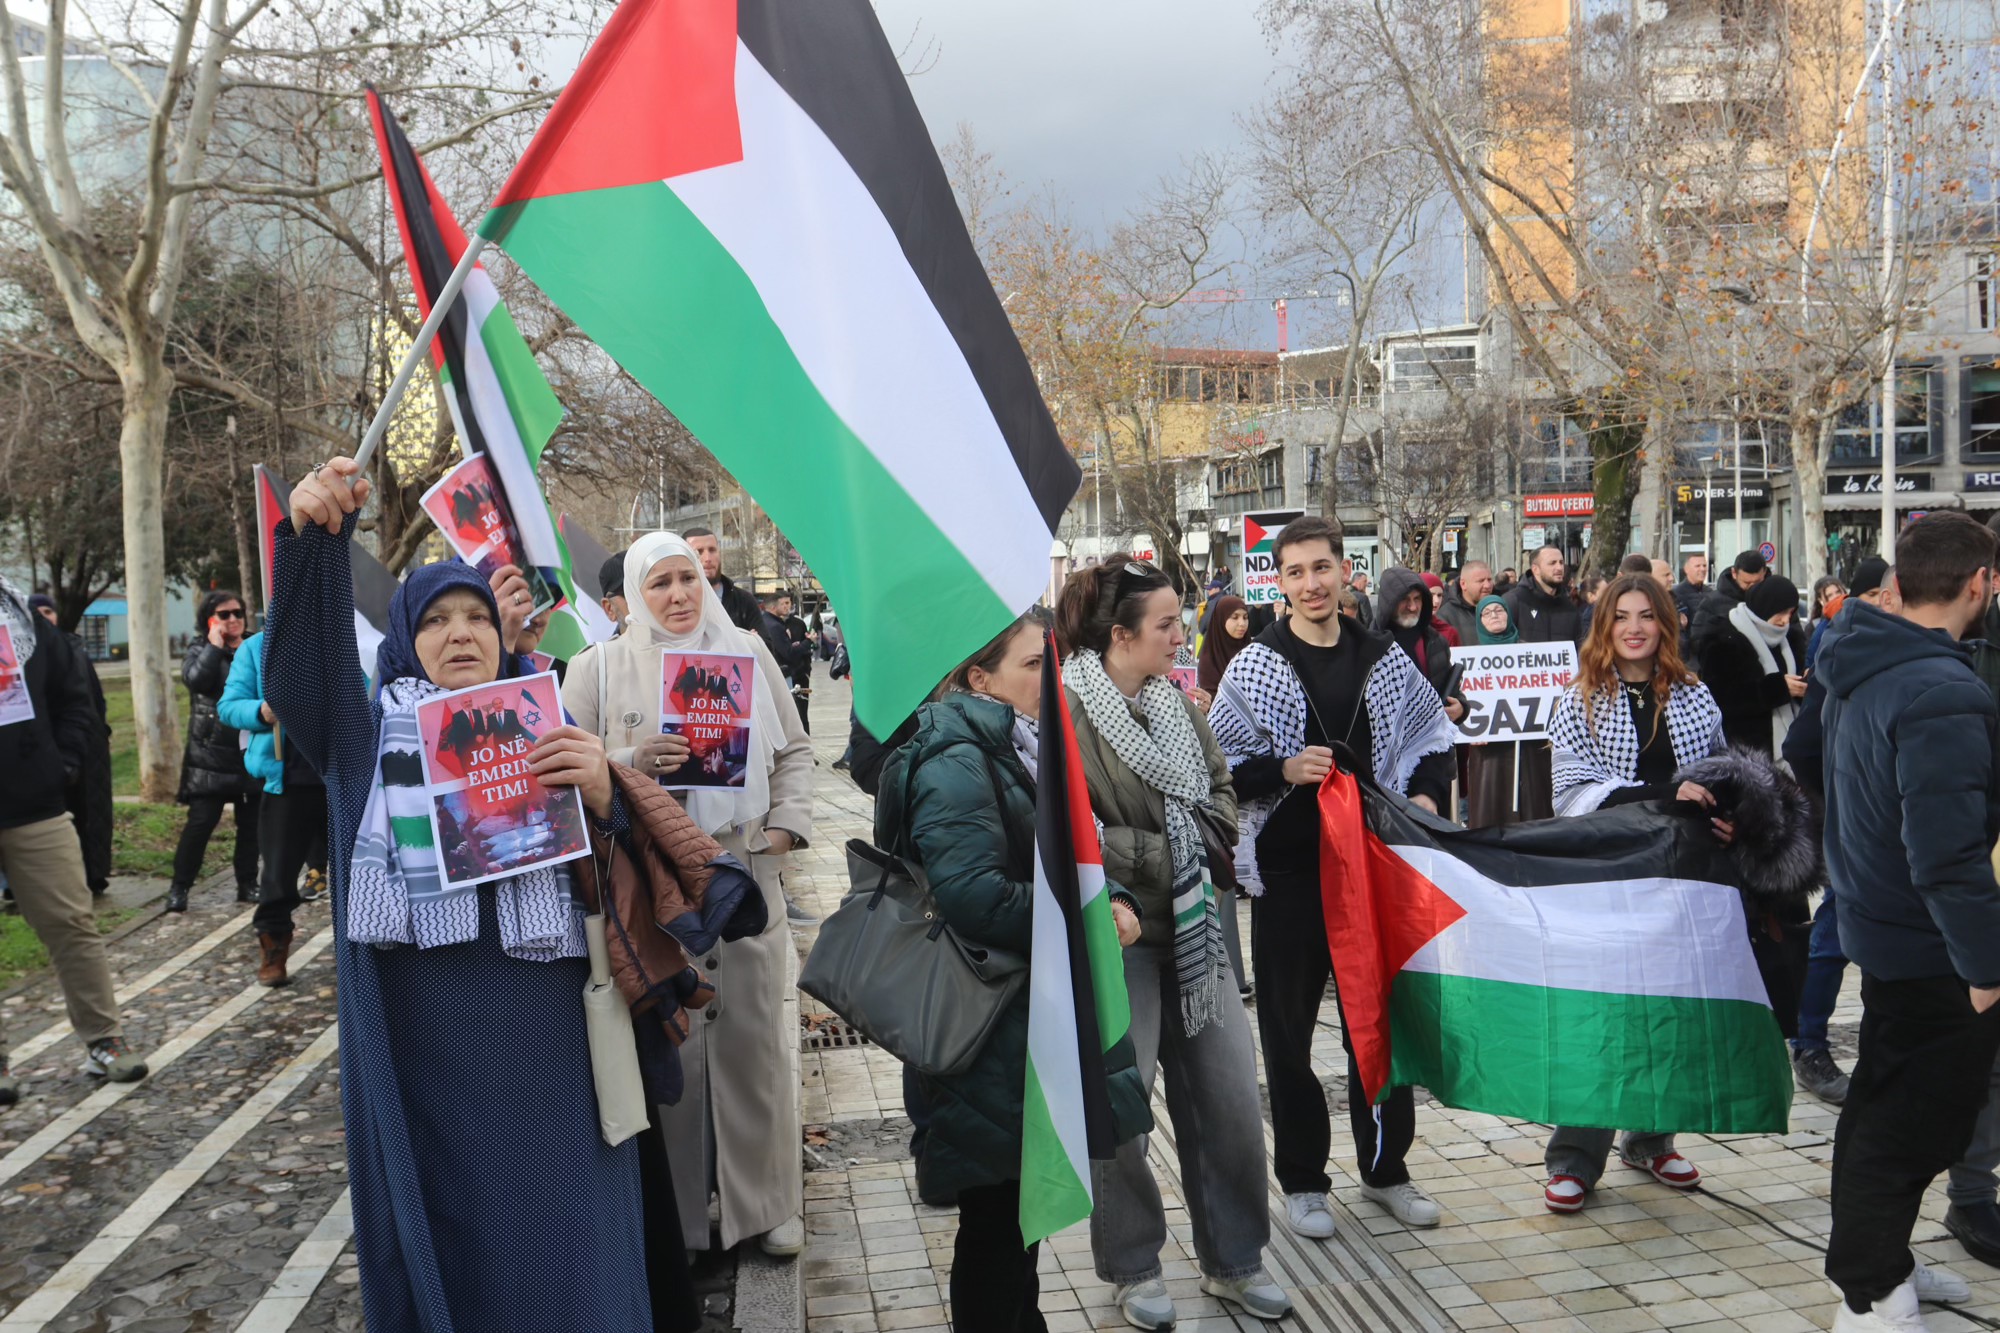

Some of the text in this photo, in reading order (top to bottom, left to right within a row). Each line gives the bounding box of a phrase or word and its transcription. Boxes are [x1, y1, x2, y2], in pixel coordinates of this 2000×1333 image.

[1843, 476, 1860, 492] te
[1727, 487, 1763, 498] Srima
[1526, 499, 1560, 512] BUTIKU
[1247, 588, 1264, 601] NE
[1517, 649, 1571, 668] FËMIJË
[1460, 669, 1571, 691] ANË VRARË NË
[690, 696, 728, 710] JO NË
[686, 711, 731, 725] EMRIN
[692, 726, 722, 739] TIM!
[470, 733, 527, 766] JO NË
[467, 758, 532, 786] EMRIN
[482, 778, 529, 803] TIM!
